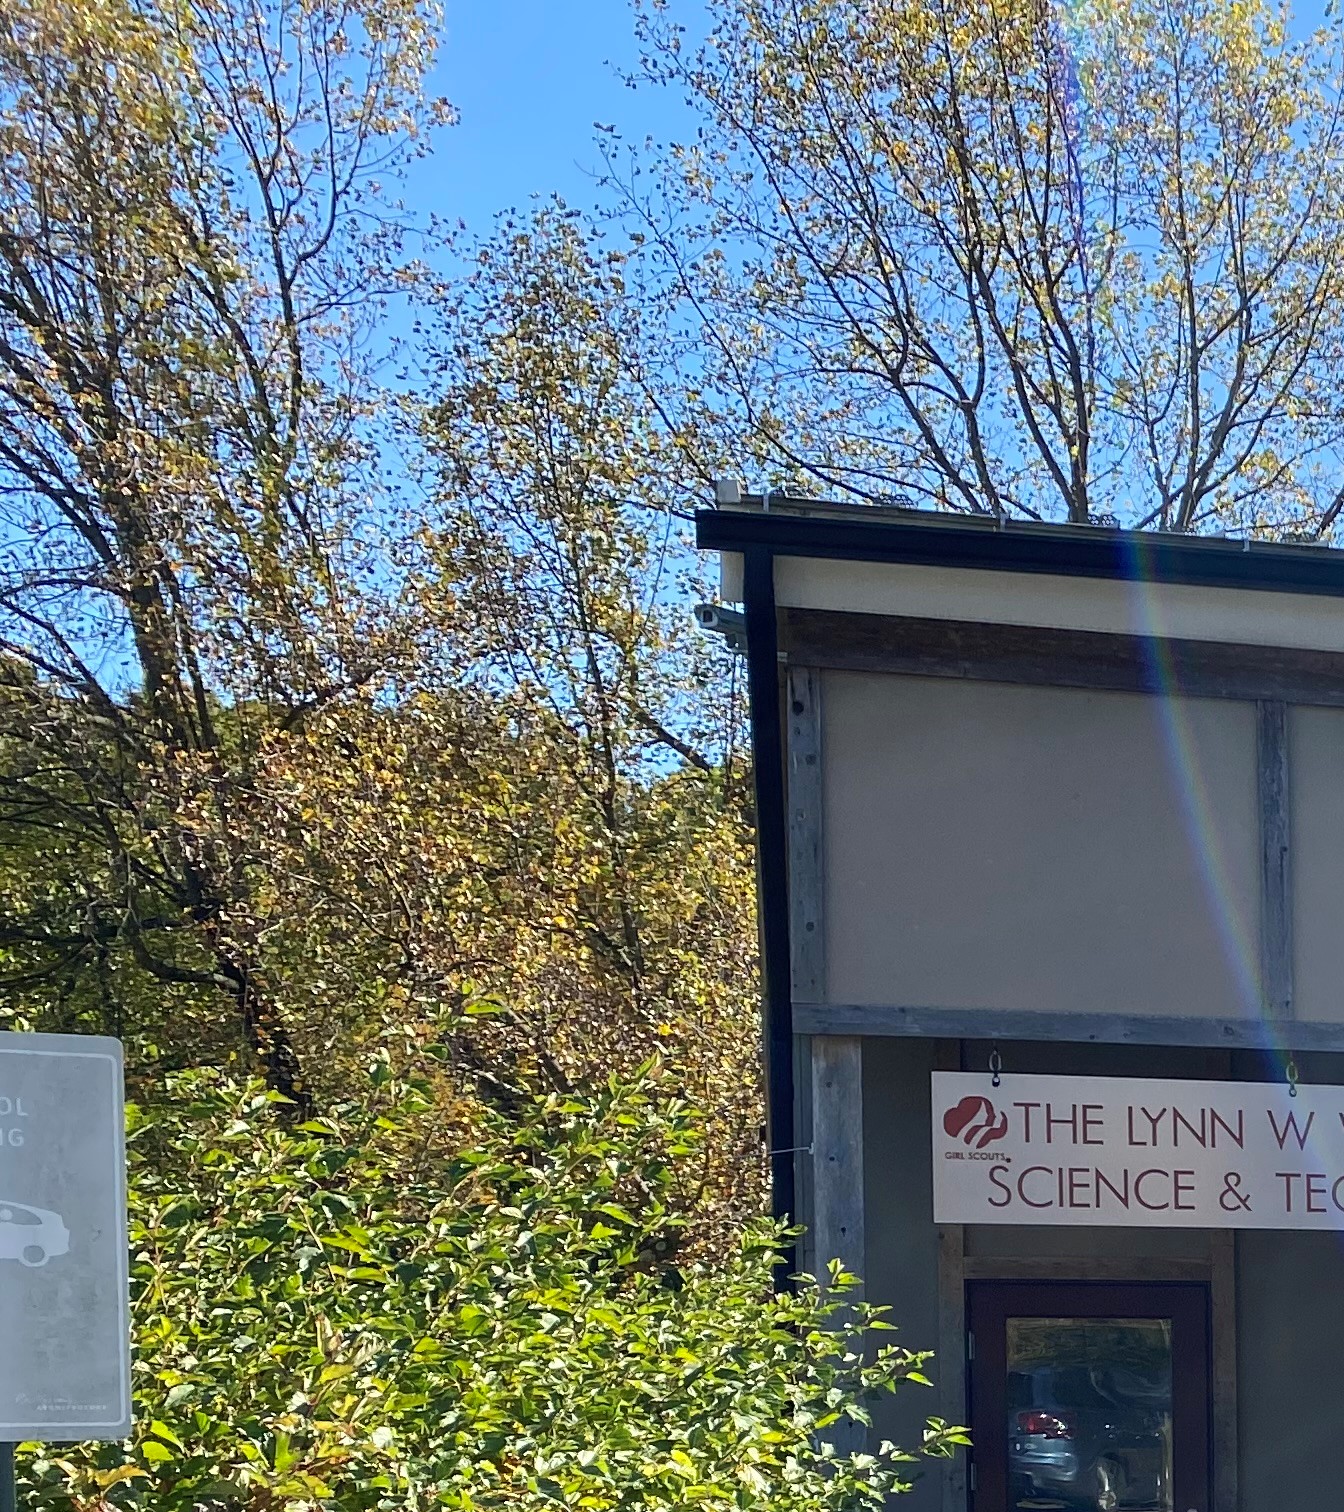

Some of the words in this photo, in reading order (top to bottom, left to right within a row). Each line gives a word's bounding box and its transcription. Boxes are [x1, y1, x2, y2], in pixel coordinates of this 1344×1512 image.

[1012, 1102, 1105, 1146] THE
[1127, 1105, 1244, 1150] LYNN
[1266, 1109, 1316, 1152] W
[944, 1151, 966, 1160] GIRL
[967, 1151, 1006, 1161] SCOUTS
[987, 1164, 1196, 1211] SCIENCE
[1218, 1171, 1253, 1212] &
